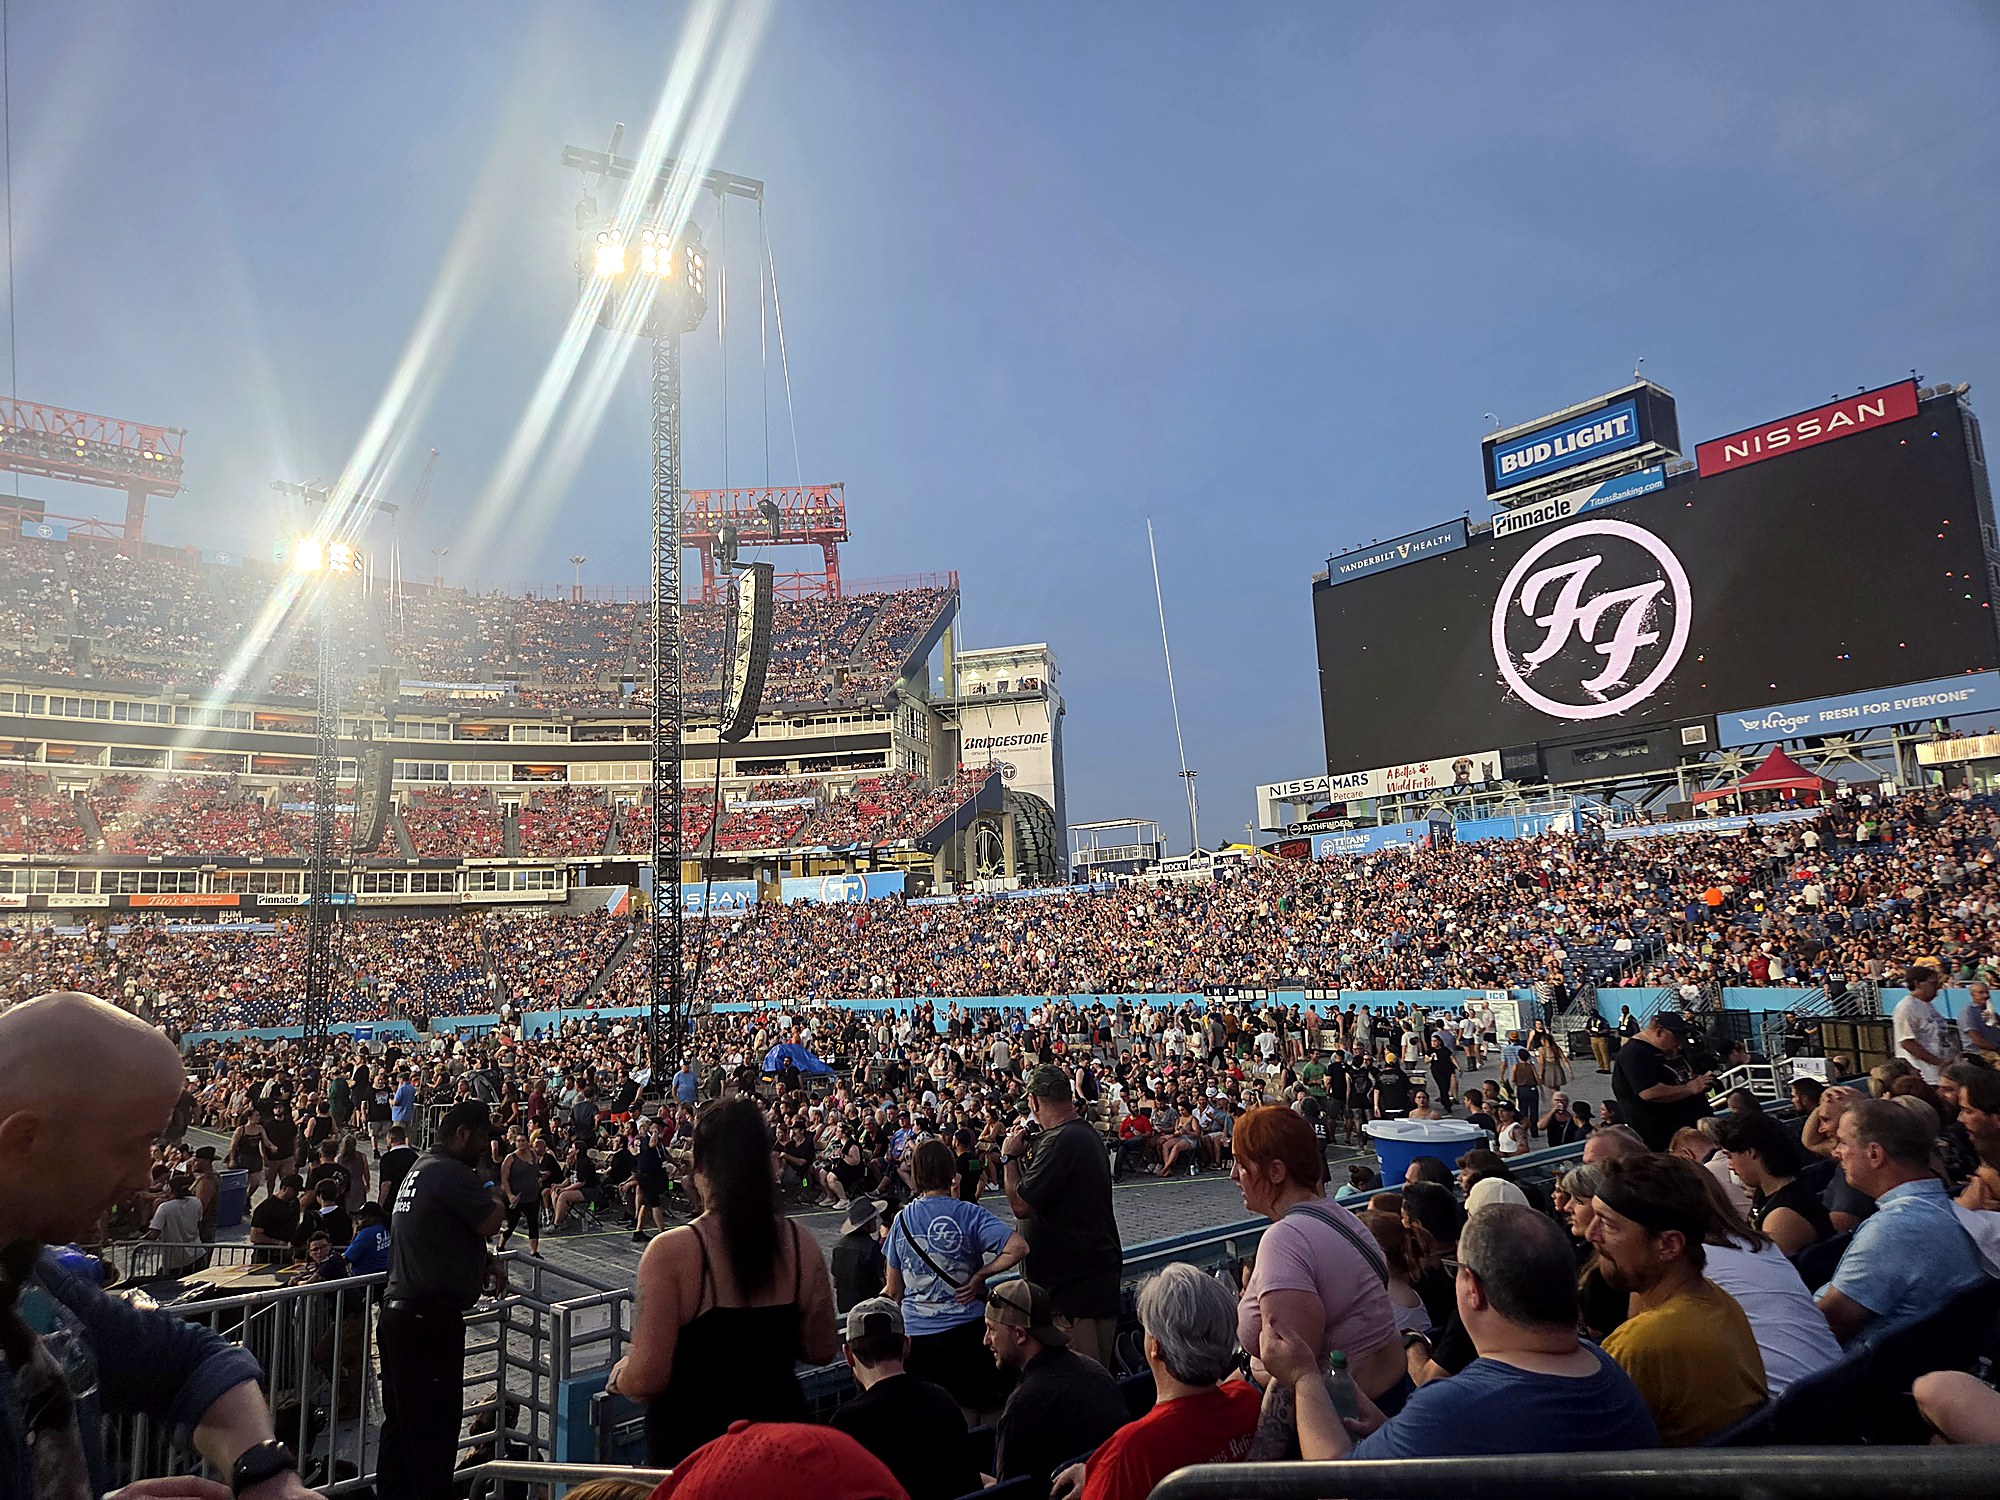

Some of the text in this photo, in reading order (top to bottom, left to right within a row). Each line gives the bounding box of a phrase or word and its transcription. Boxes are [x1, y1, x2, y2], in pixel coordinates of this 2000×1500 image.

[1724, 398, 1885, 462] NISSAN
[1501, 414, 1630, 474] BUD LIGHT
[1590, 480, 1663, 508] TitansBanking.com
[1496, 499, 1571, 535] Pinnacle
[1340, 551, 1395, 573] VANDERBILT
[1413, 534, 1451, 552] HEALTH
[1762, 711, 1810, 734] Kroger
[1819, 707, 1860, 722] FRESH
[1863, 701, 1891, 714] FOR
[964, 733, 1049, 750] BRIDGESTONE
[1332, 773, 1369, 790] MARS
[1386, 768, 1394, 780] A
[1270, 778, 1329, 797] NISSA
[1386, 781, 1411, 793] World
[1423, 776, 1437, 787] Pets
[1333, 790, 1364, 801] Petcare
[1674, 821, 1720, 833] TITANS
[1334, 834, 1371, 846] TITANS
[1164, 861, 1187, 872] ROCKY
[148, 896, 179, 906] Tito's
[258, 896, 299, 904] Pinnacle
[681, 891, 751, 906] ISSAN
[219, 910, 242, 918] BUM
